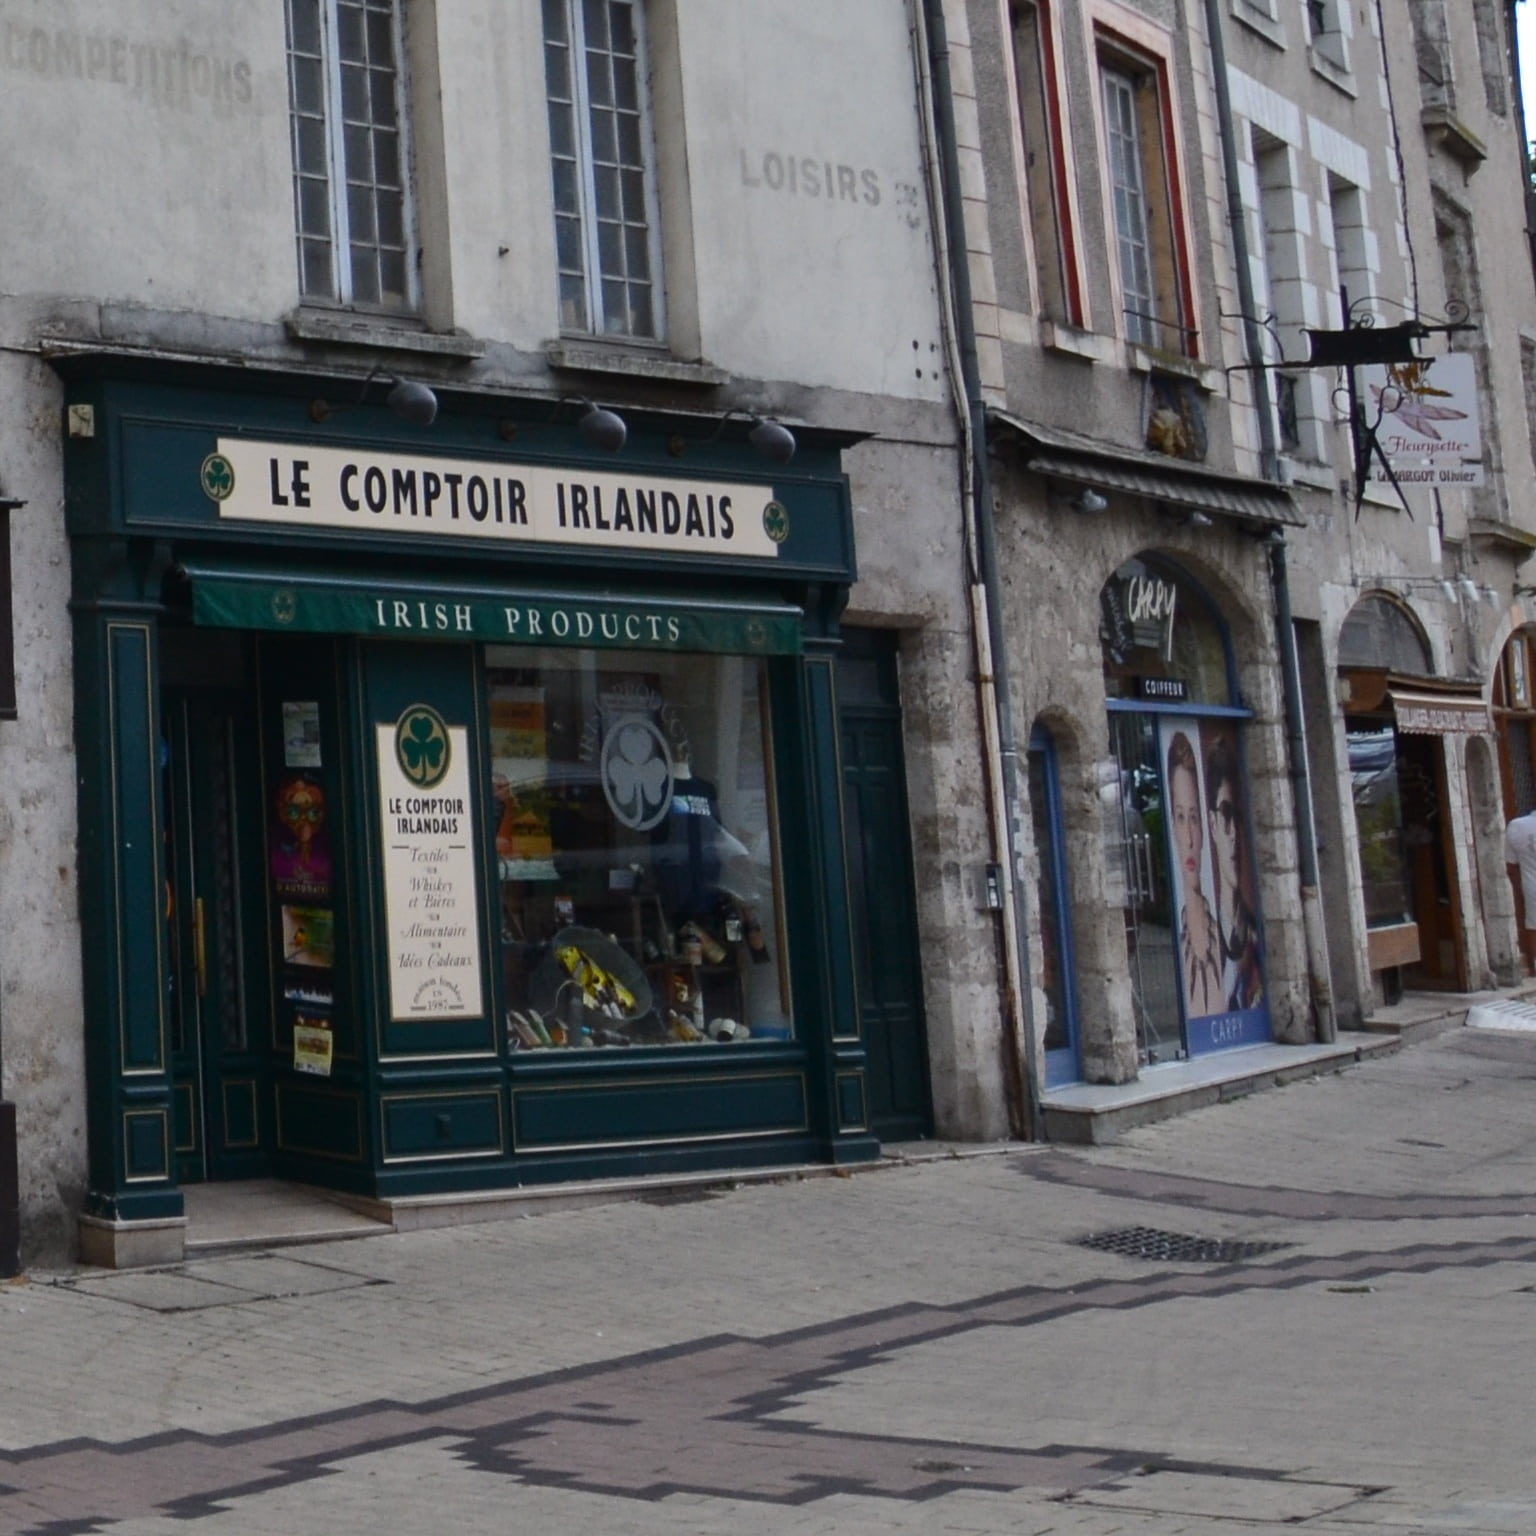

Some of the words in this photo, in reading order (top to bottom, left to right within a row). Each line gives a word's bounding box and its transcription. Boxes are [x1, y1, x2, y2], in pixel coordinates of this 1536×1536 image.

[739, 148, 881, 207] LOISIRS
[270, 458, 311, 508] LE
[340, 463, 529, 525] COMPTOIR
[557, 482, 735, 540] IRLANDAIS
[376, 599, 474, 632] IRISH
[506, 606, 680, 642] PRODUCTS
[389, 798, 402, 814] LE
[406, 798, 464, 815] COMPTOIR
[397, 817, 458, 835] IRLANDAIS
[400, 923, 467, 938] Alimentaire
[398, 952, 424, 969] Idées
[428, 951, 473, 969] Cadeaux
[427, 999, 448, 1011] 1987
